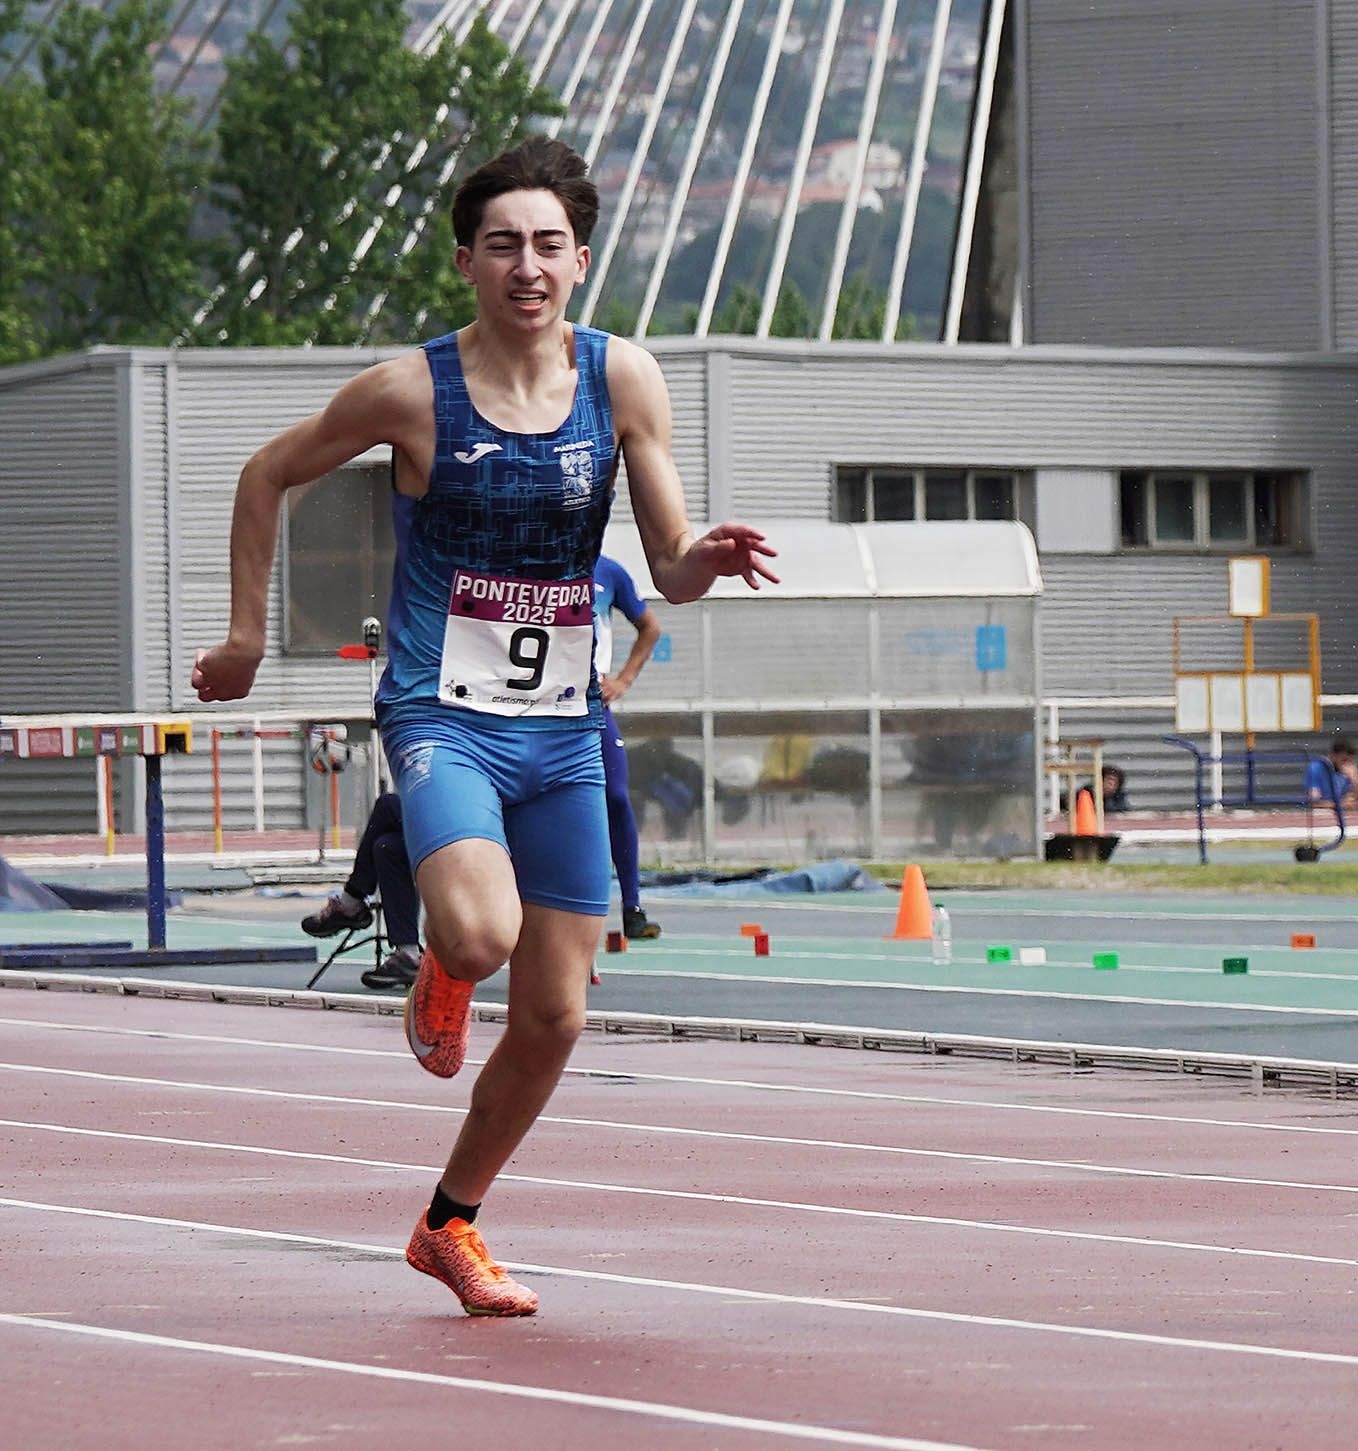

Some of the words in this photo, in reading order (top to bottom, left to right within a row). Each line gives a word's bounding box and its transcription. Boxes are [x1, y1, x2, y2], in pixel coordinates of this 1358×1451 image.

[455, 575, 591, 607] PONTEVEDRA
[502, 602, 557, 625] 2025
[506, 626, 550, 691] 9
